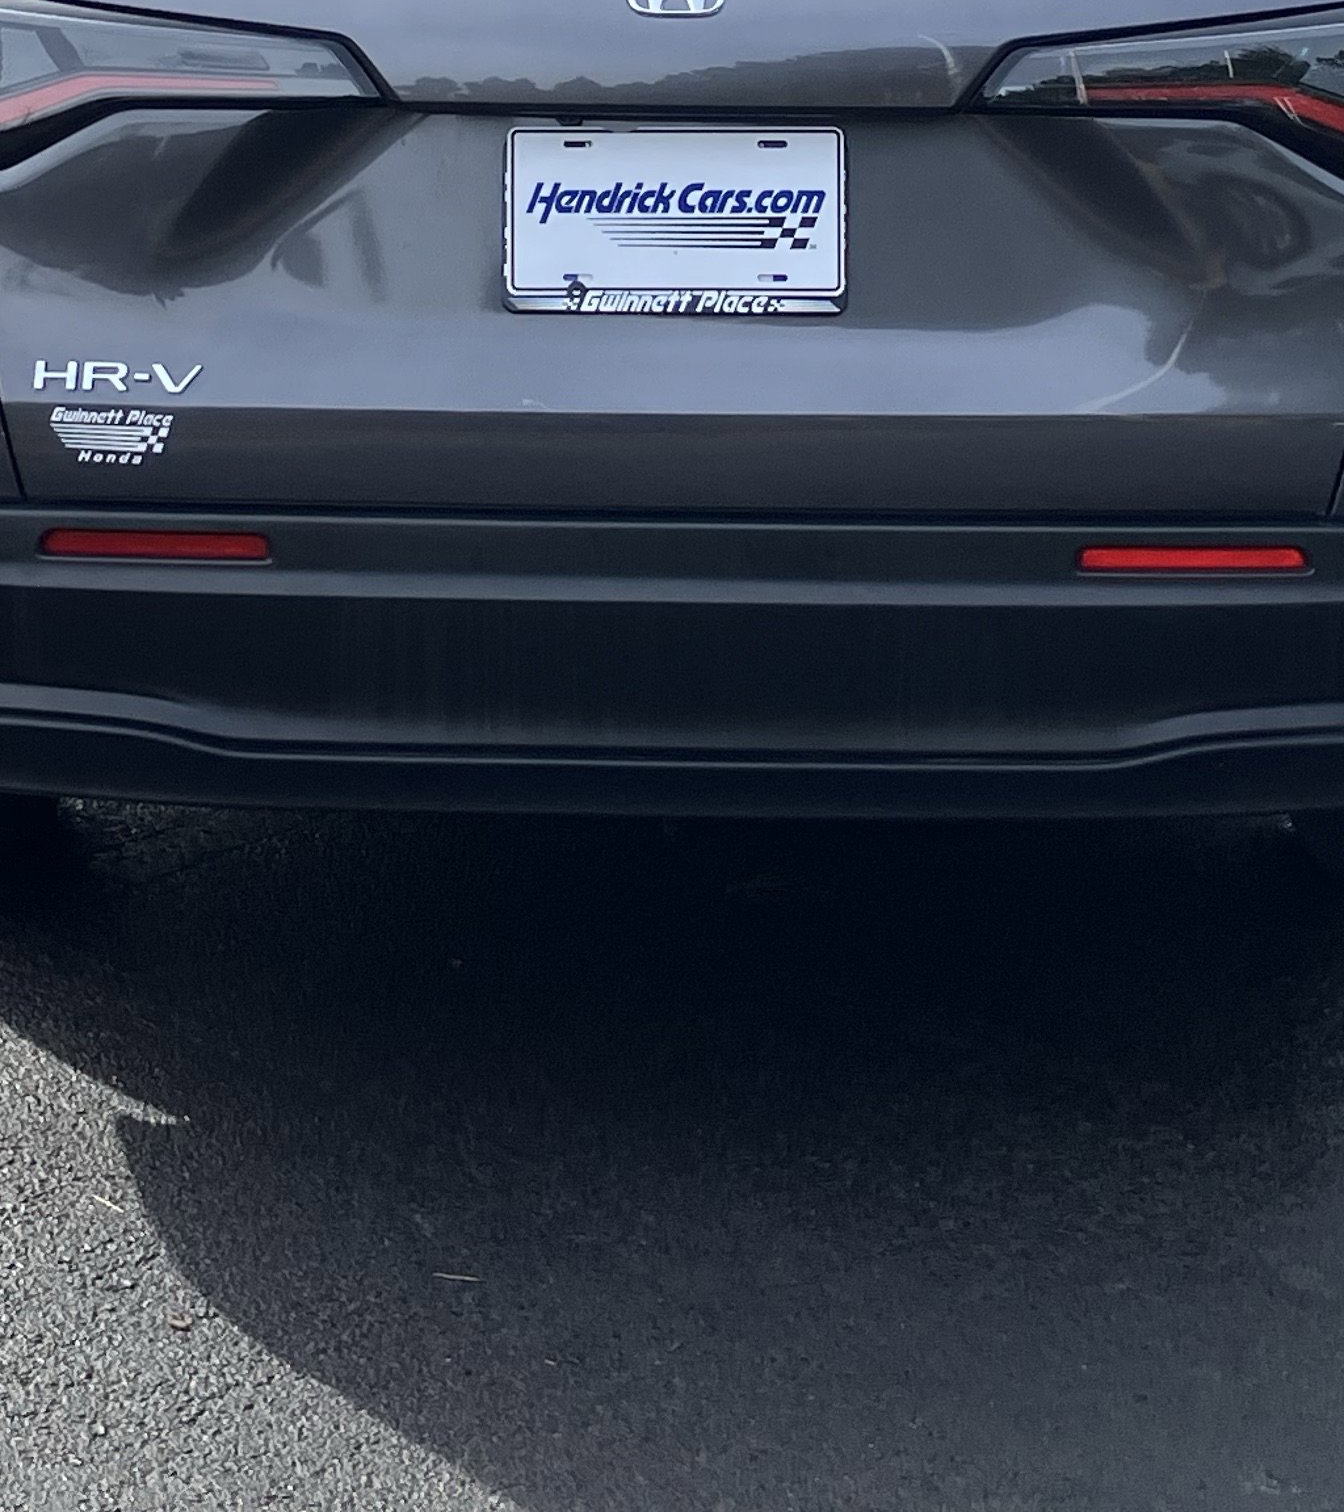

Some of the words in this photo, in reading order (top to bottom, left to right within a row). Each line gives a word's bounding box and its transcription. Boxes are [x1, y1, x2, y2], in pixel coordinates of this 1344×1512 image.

[580, 289, 694, 314] Gwinnett
[695, 290, 770, 315] Place
[33, 360, 204, 394] HR-V
[49, 406, 125, 425] Gwinnett
[125, 409, 174, 427] Place
[77, 450, 144, 466] Honda
